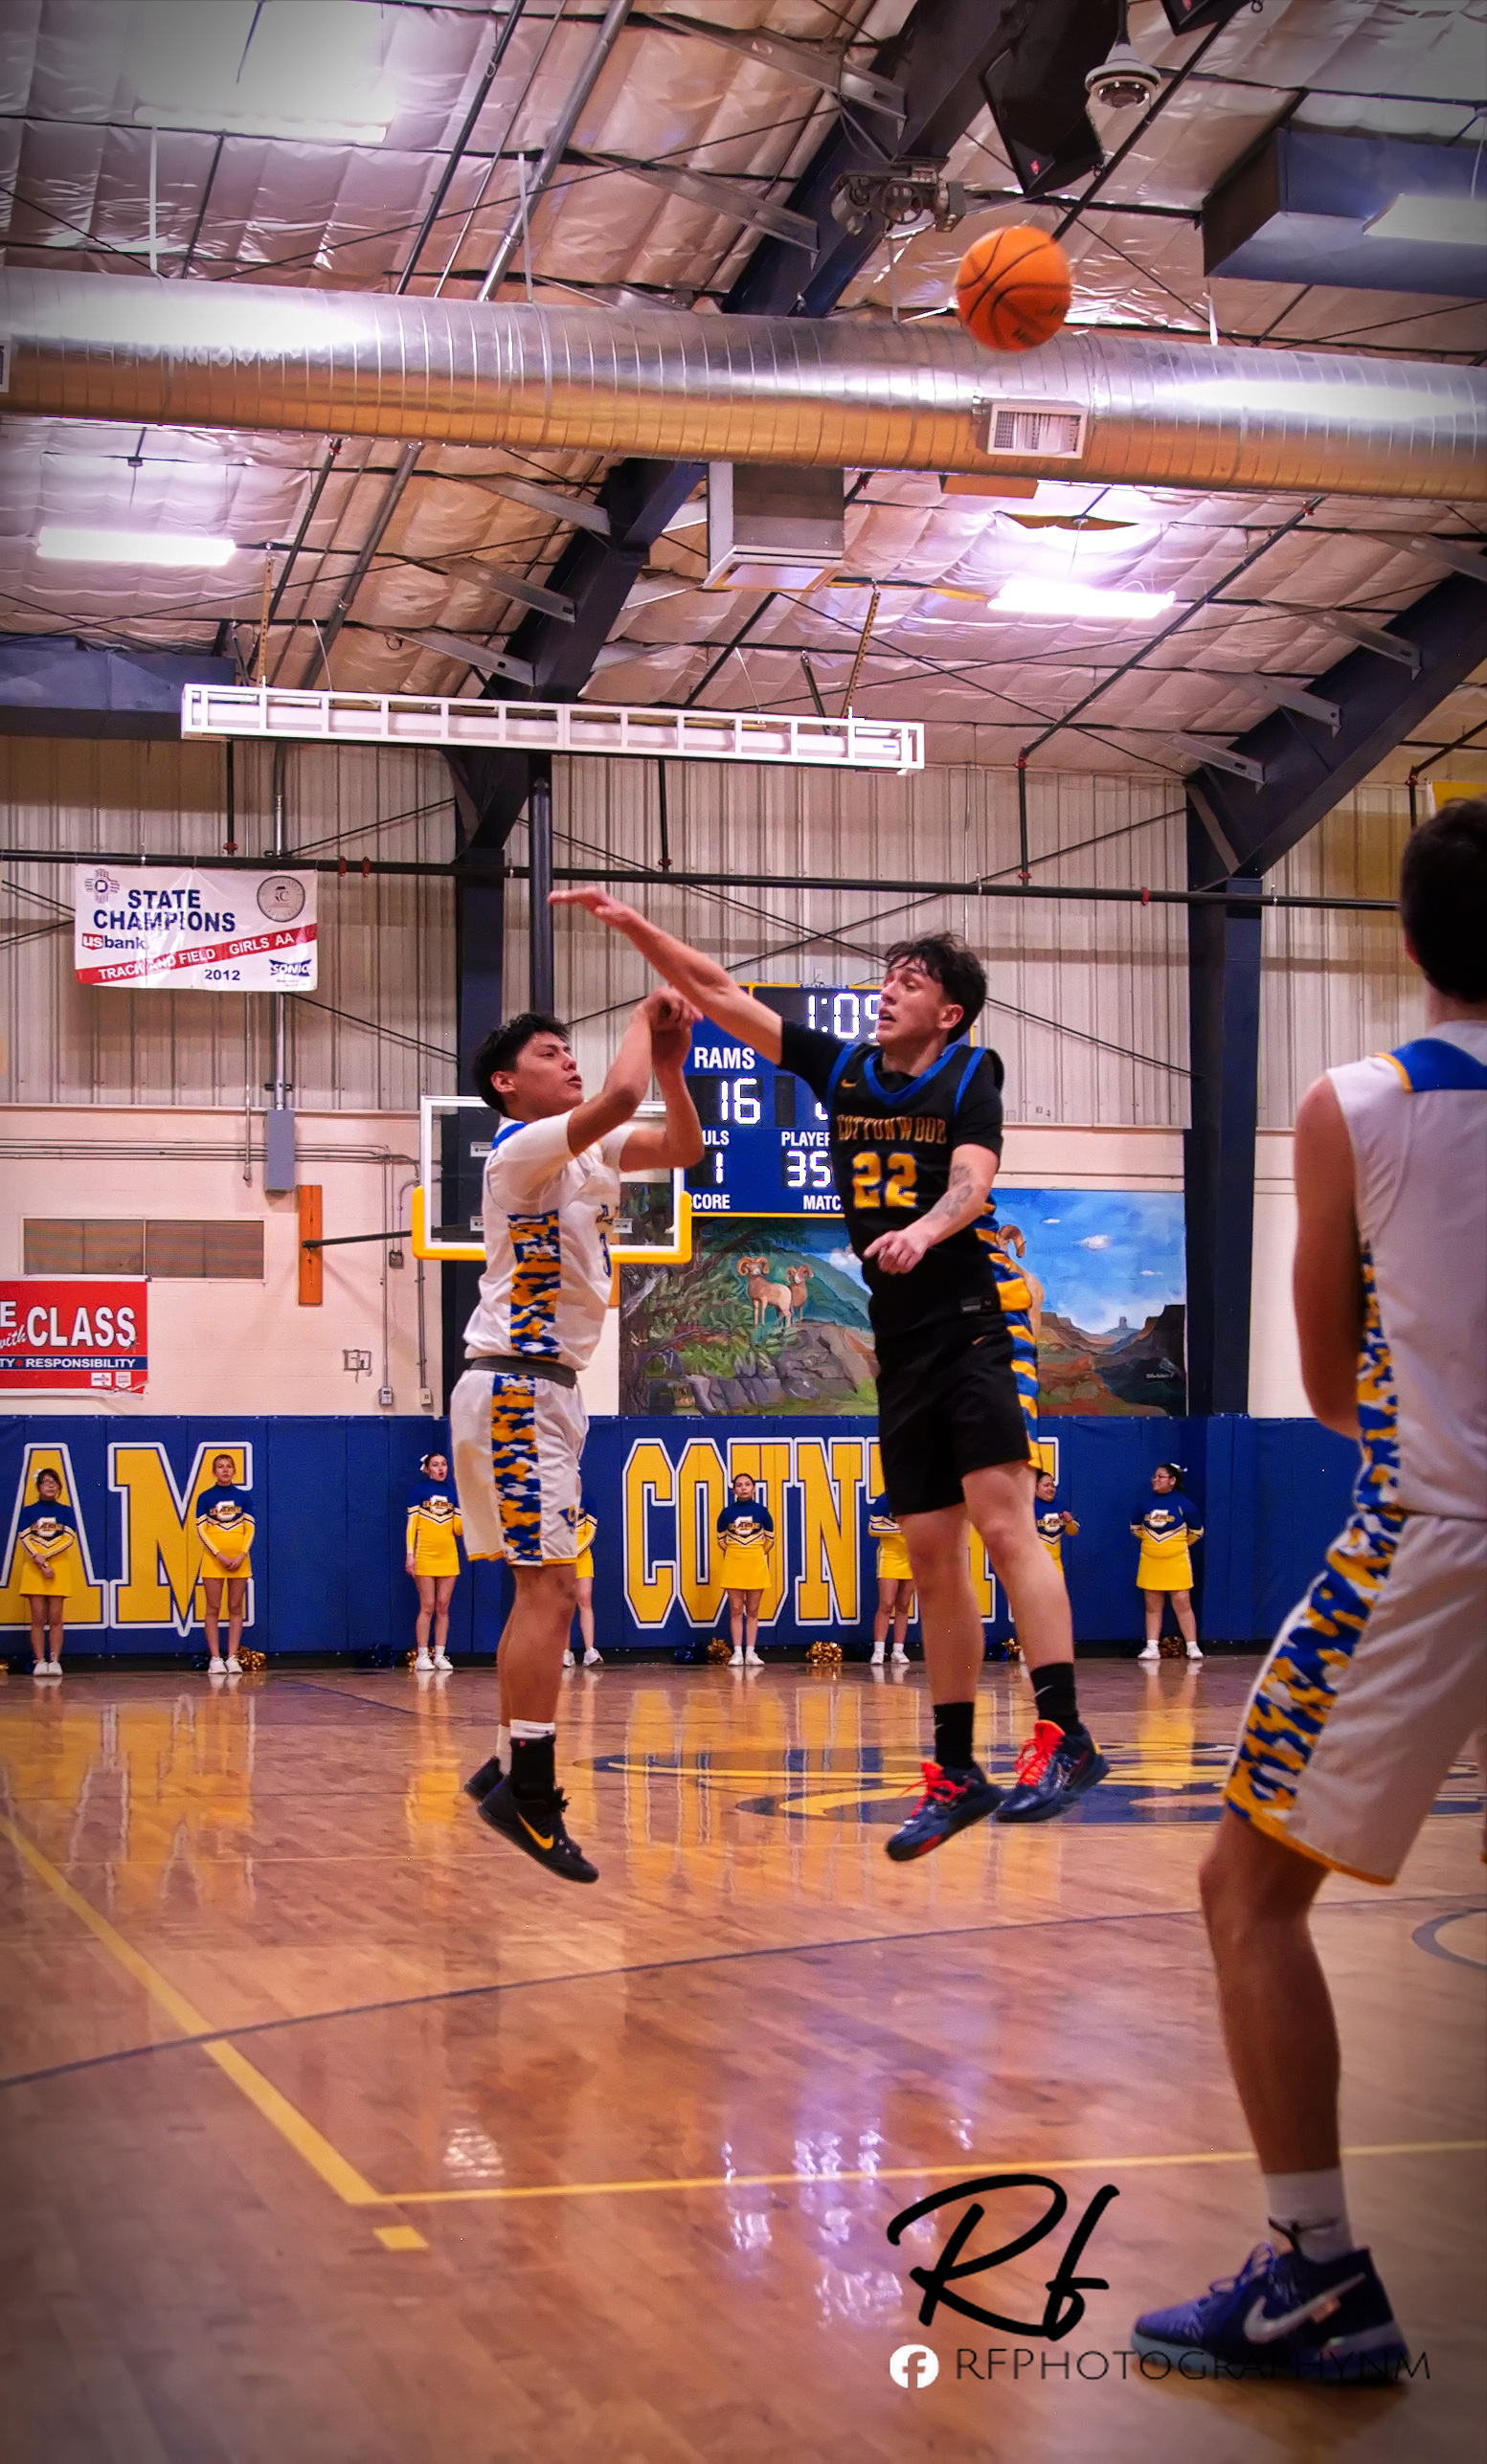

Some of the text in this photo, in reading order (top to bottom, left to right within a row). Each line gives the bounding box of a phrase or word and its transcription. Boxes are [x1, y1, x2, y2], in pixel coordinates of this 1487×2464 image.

[127, 888, 201, 909] STATE
[93, 908, 237, 933] CHAMPIONS
[98, 932, 295, 980] TRACK AND FIELD GIRLS AA
[269, 960, 311, 976] SONIC
[204, 968, 240, 981] 2012
[694, 1046, 755, 1070] RAMS
[721, 1077, 761, 1125] 16
[701, 1130, 730, 1146] ULS
[715, 1151, 724, 1184] 1
[786, 1149, 832, 1187] 35
[851, 1151, 918, 1209] 22
[690, 1194, 731, 1210] CORE
[802, 1195, 844, 1211] MATC
[27, 1305, 136, 1348] CLASS
[25, 1357, 136, 1369] RESPONSIBILITY
